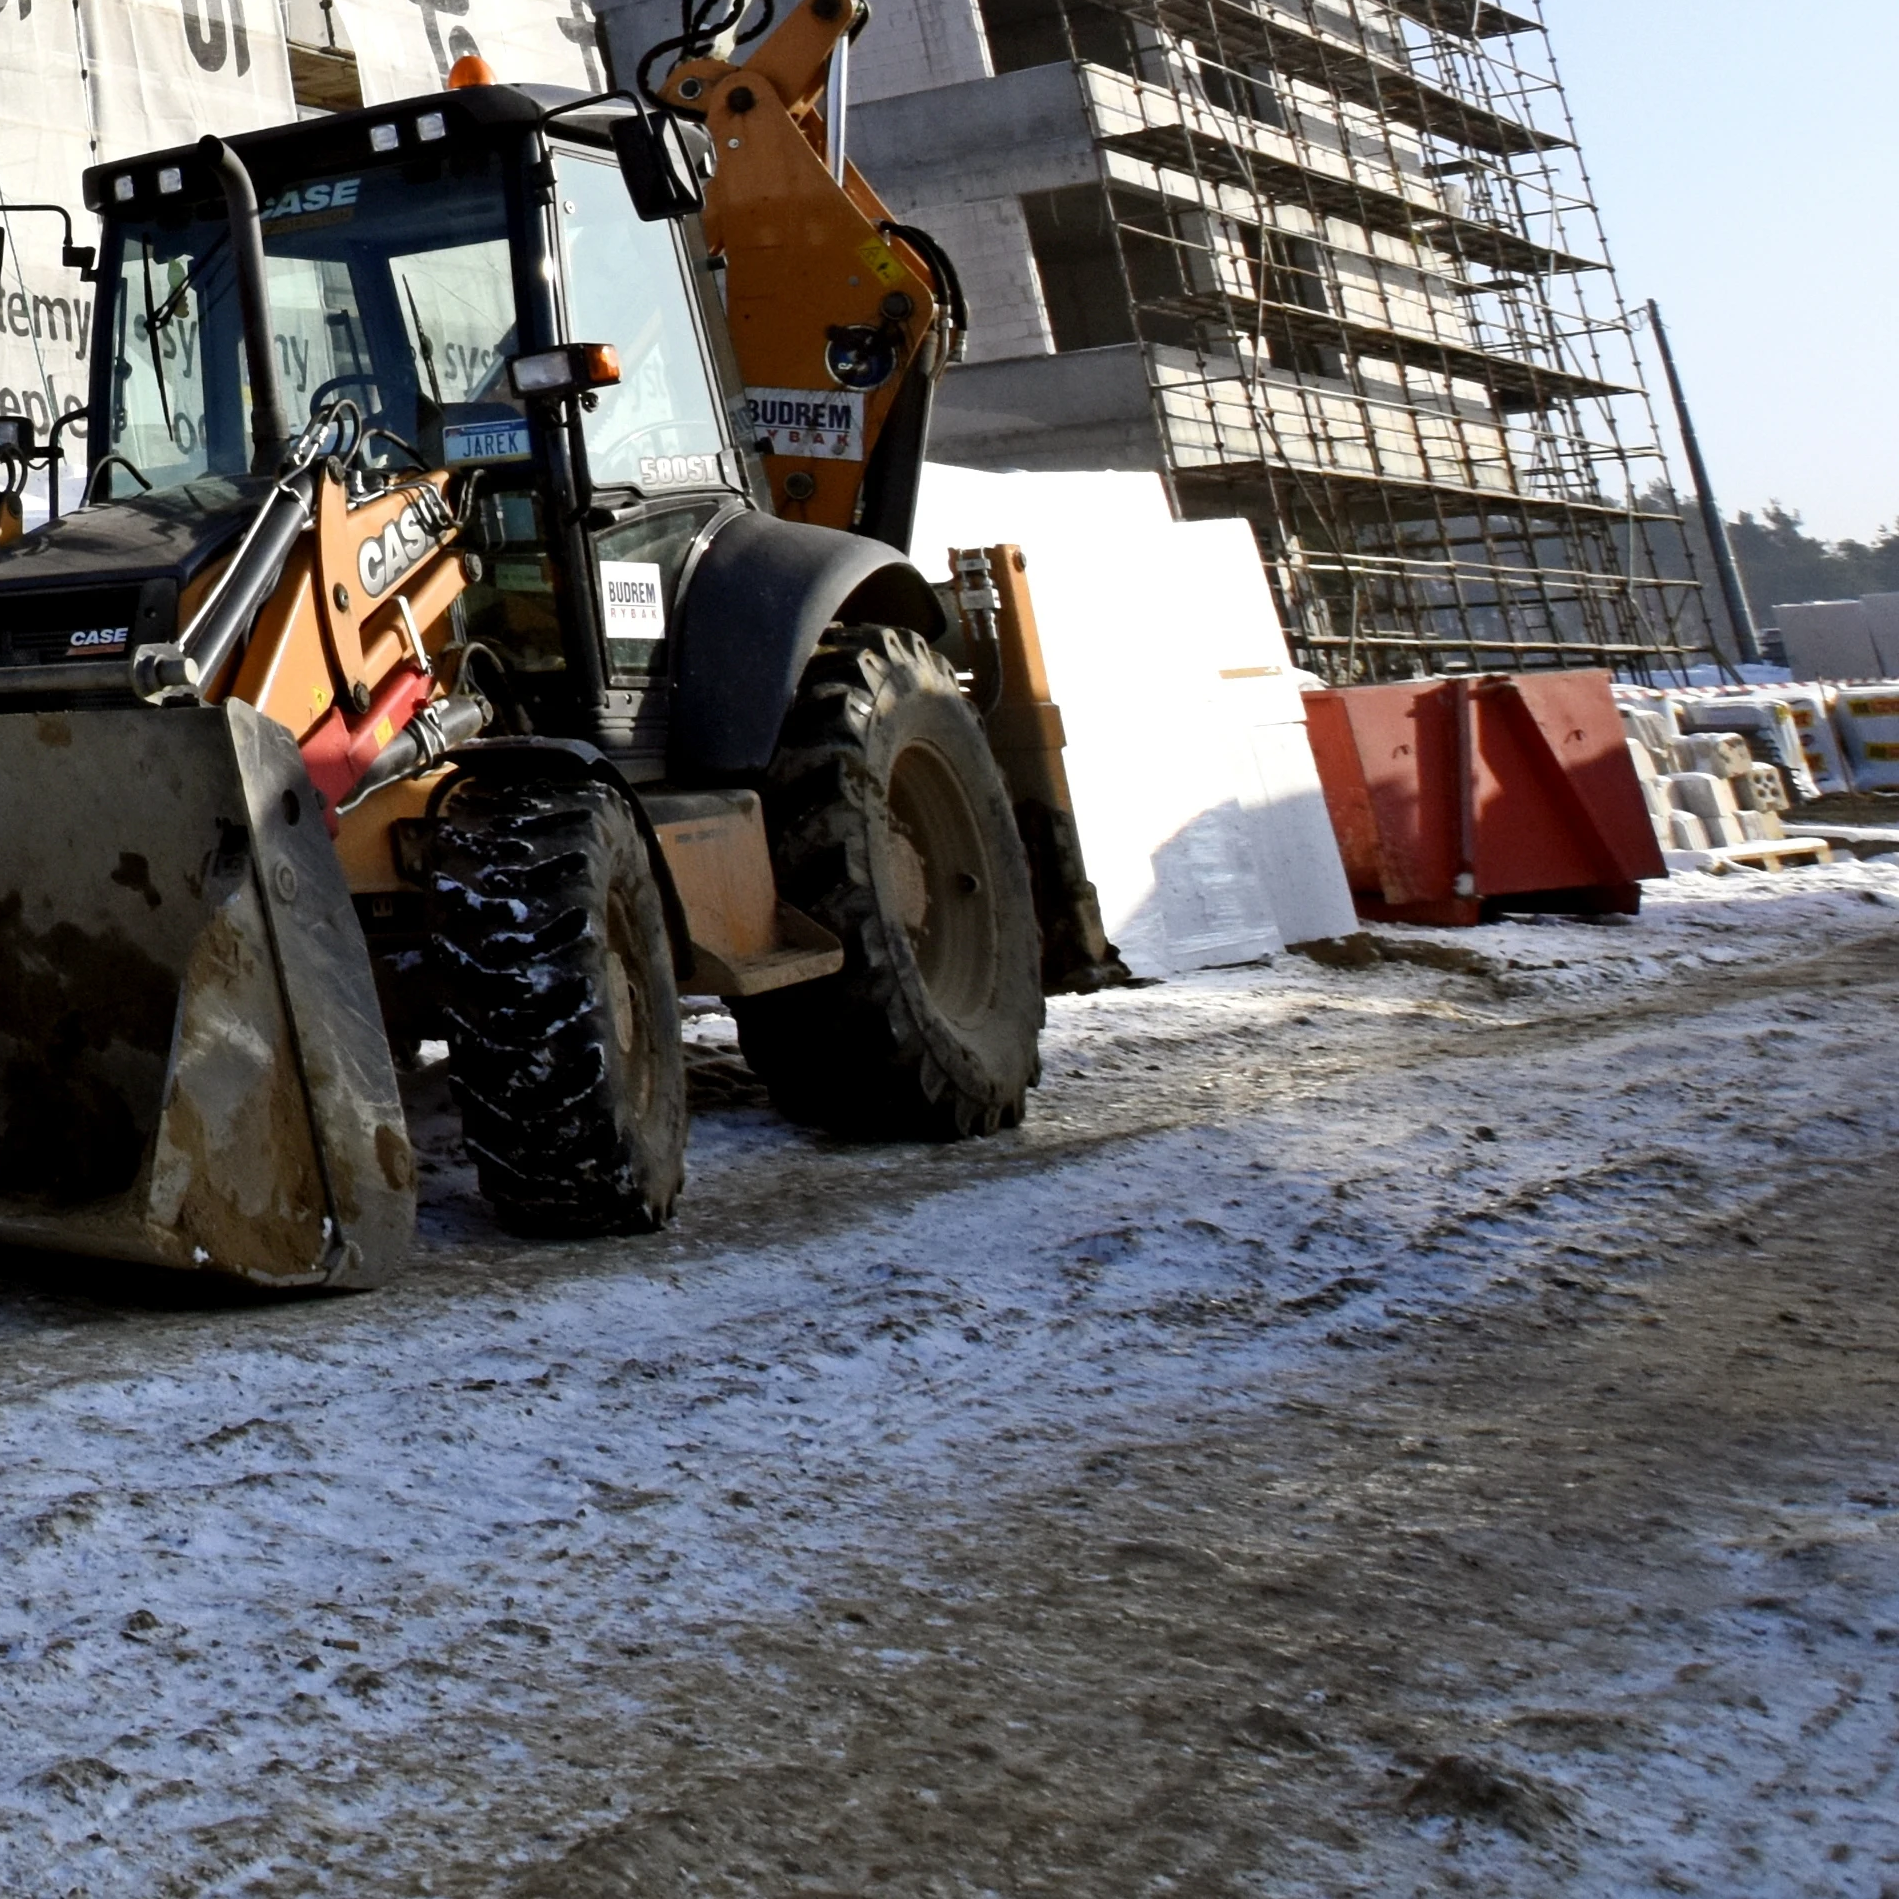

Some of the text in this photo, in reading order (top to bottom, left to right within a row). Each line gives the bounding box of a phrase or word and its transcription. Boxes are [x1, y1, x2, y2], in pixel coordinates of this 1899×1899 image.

[463, 431, 519, 458] JAREK
[639, 454, 717, 485] 580ST
[357, 490, 443, 598] CAS
[608, 581, 657, 604] BUDREM
[70, 627, 129, 647] CASE
